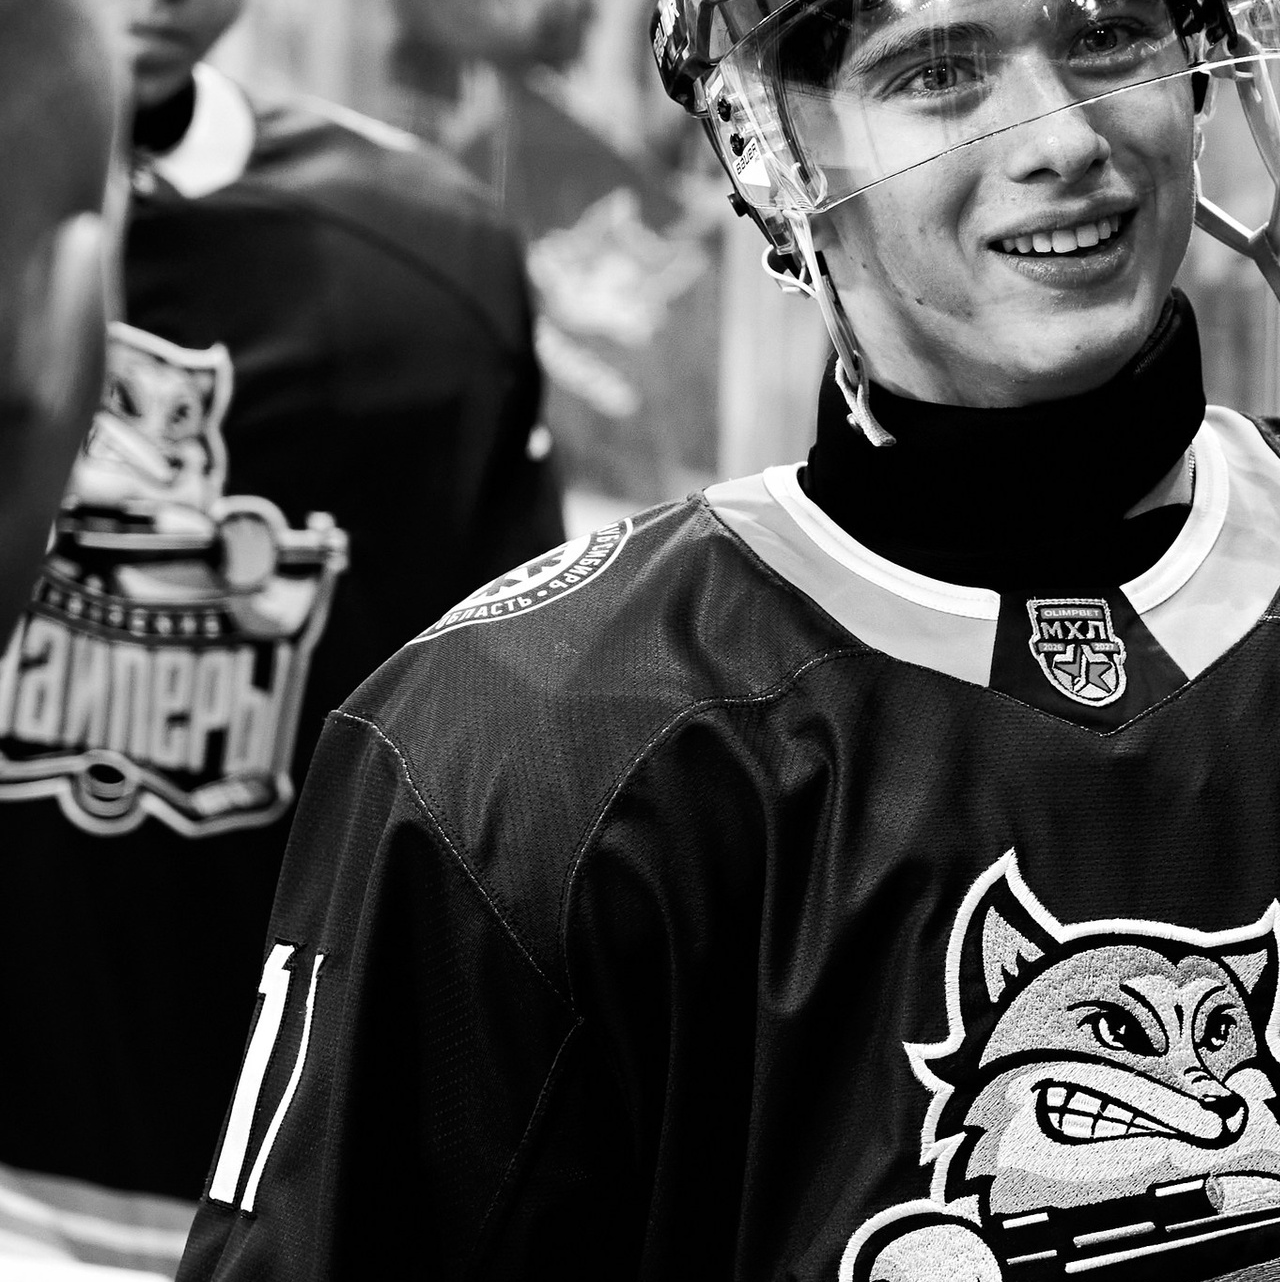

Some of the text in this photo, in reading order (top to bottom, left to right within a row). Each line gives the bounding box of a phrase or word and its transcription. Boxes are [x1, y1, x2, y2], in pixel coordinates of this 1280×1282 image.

[550, 541, 614, 590] СИБИРЬ
[1043, 609, 1100, 617] OLIMPBET
[1040, 620, 1107, 640] МХЛ
